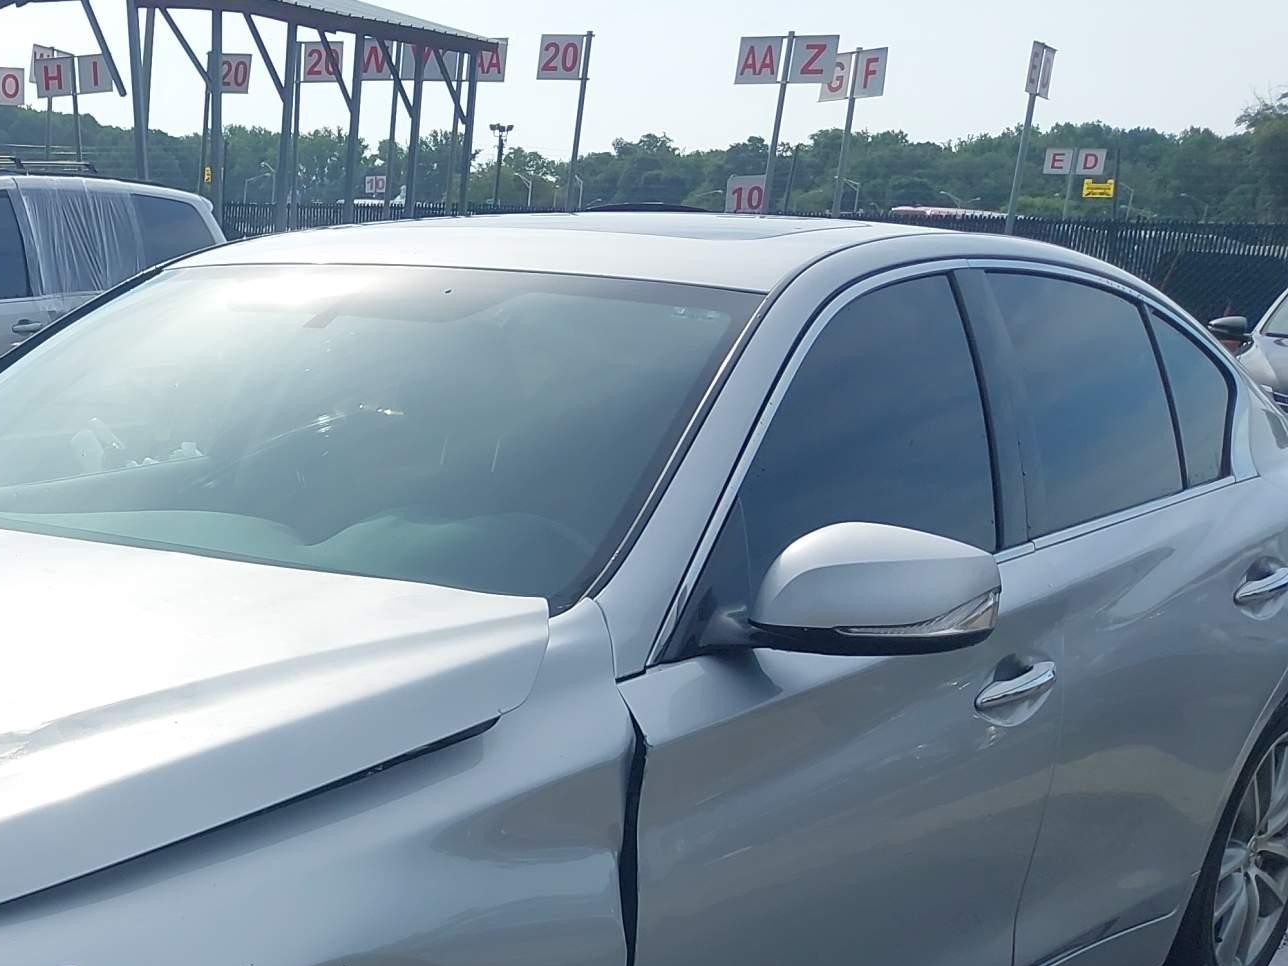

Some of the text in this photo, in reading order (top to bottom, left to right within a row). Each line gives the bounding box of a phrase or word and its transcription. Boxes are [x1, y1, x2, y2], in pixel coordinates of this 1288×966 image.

[307, 49, 340, 75] 20
[541, 42, 579, 73] 20
[740, 45, 775, 76] AA
[800, 44, 827, 75] Z
[44, 64, 63, 91] H
[92, 61, 99, 87] I
[222, 60, 248, 87] 20
[827, 62, 845, 93] G
[863, 57, 880, 89] F
[1051, 153, 1066, 169] E
[1083, 153, 1099, 170] D
[732, 185, 764, 210] 10
